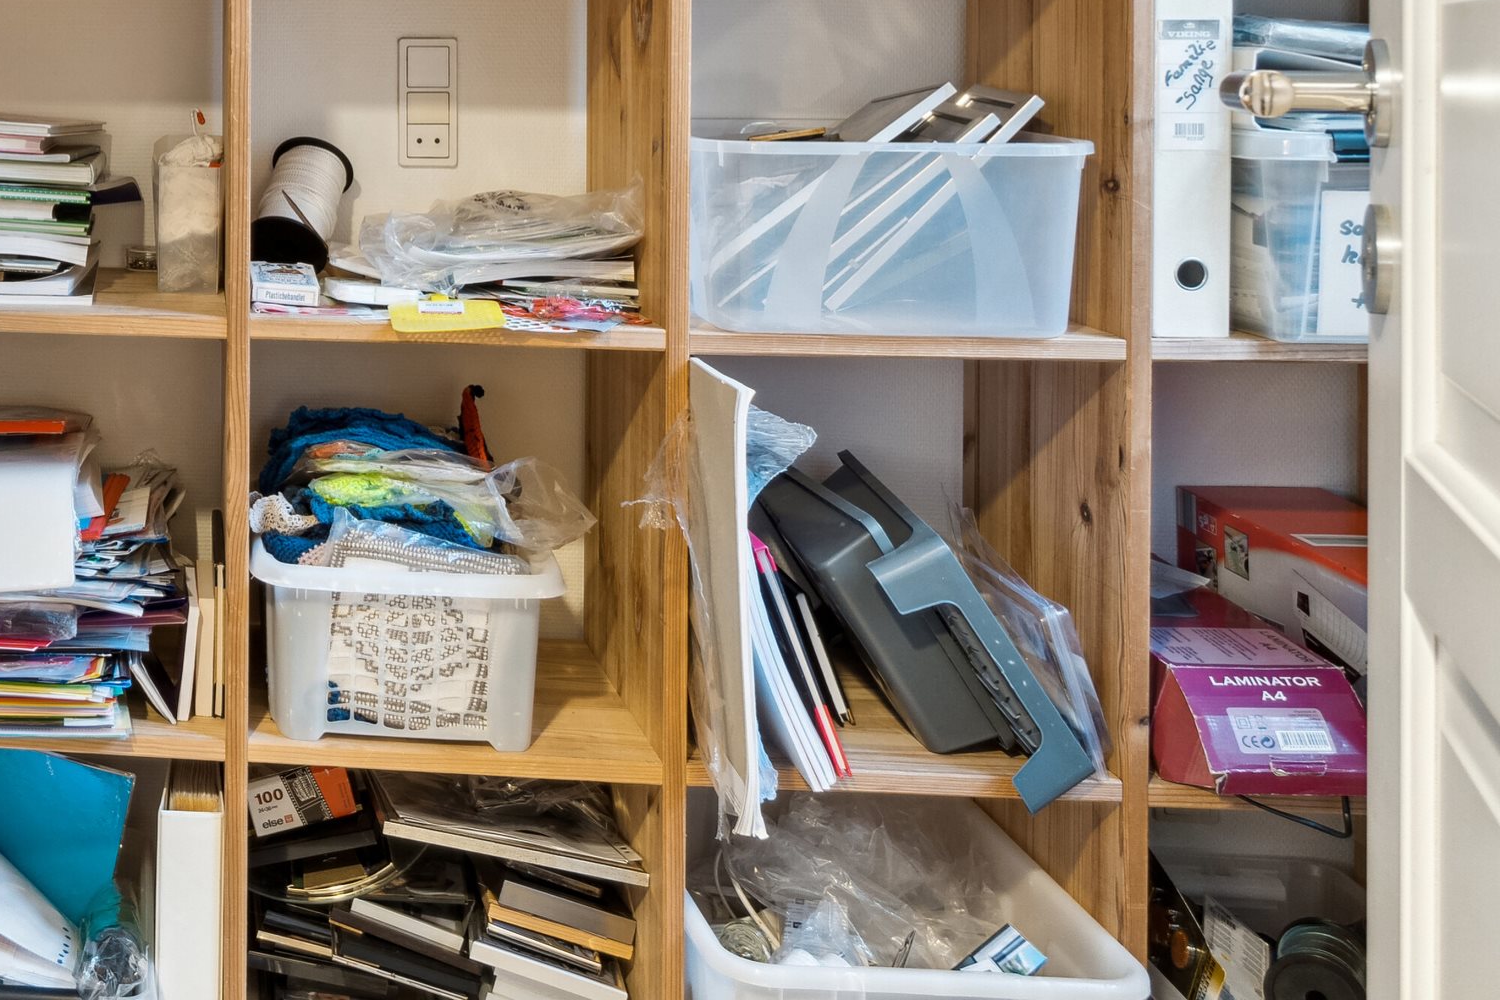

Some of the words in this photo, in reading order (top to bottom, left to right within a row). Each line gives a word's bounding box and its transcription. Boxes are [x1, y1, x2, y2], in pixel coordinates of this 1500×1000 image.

[1167, 30, 1211, 39] VIKING
[1208, 675, 1322, 687] LAMINATOR
[1261, 690, 1288, 702] A4
[254, 788, 284, 805] 100
[262, 817, 284, 829] else
